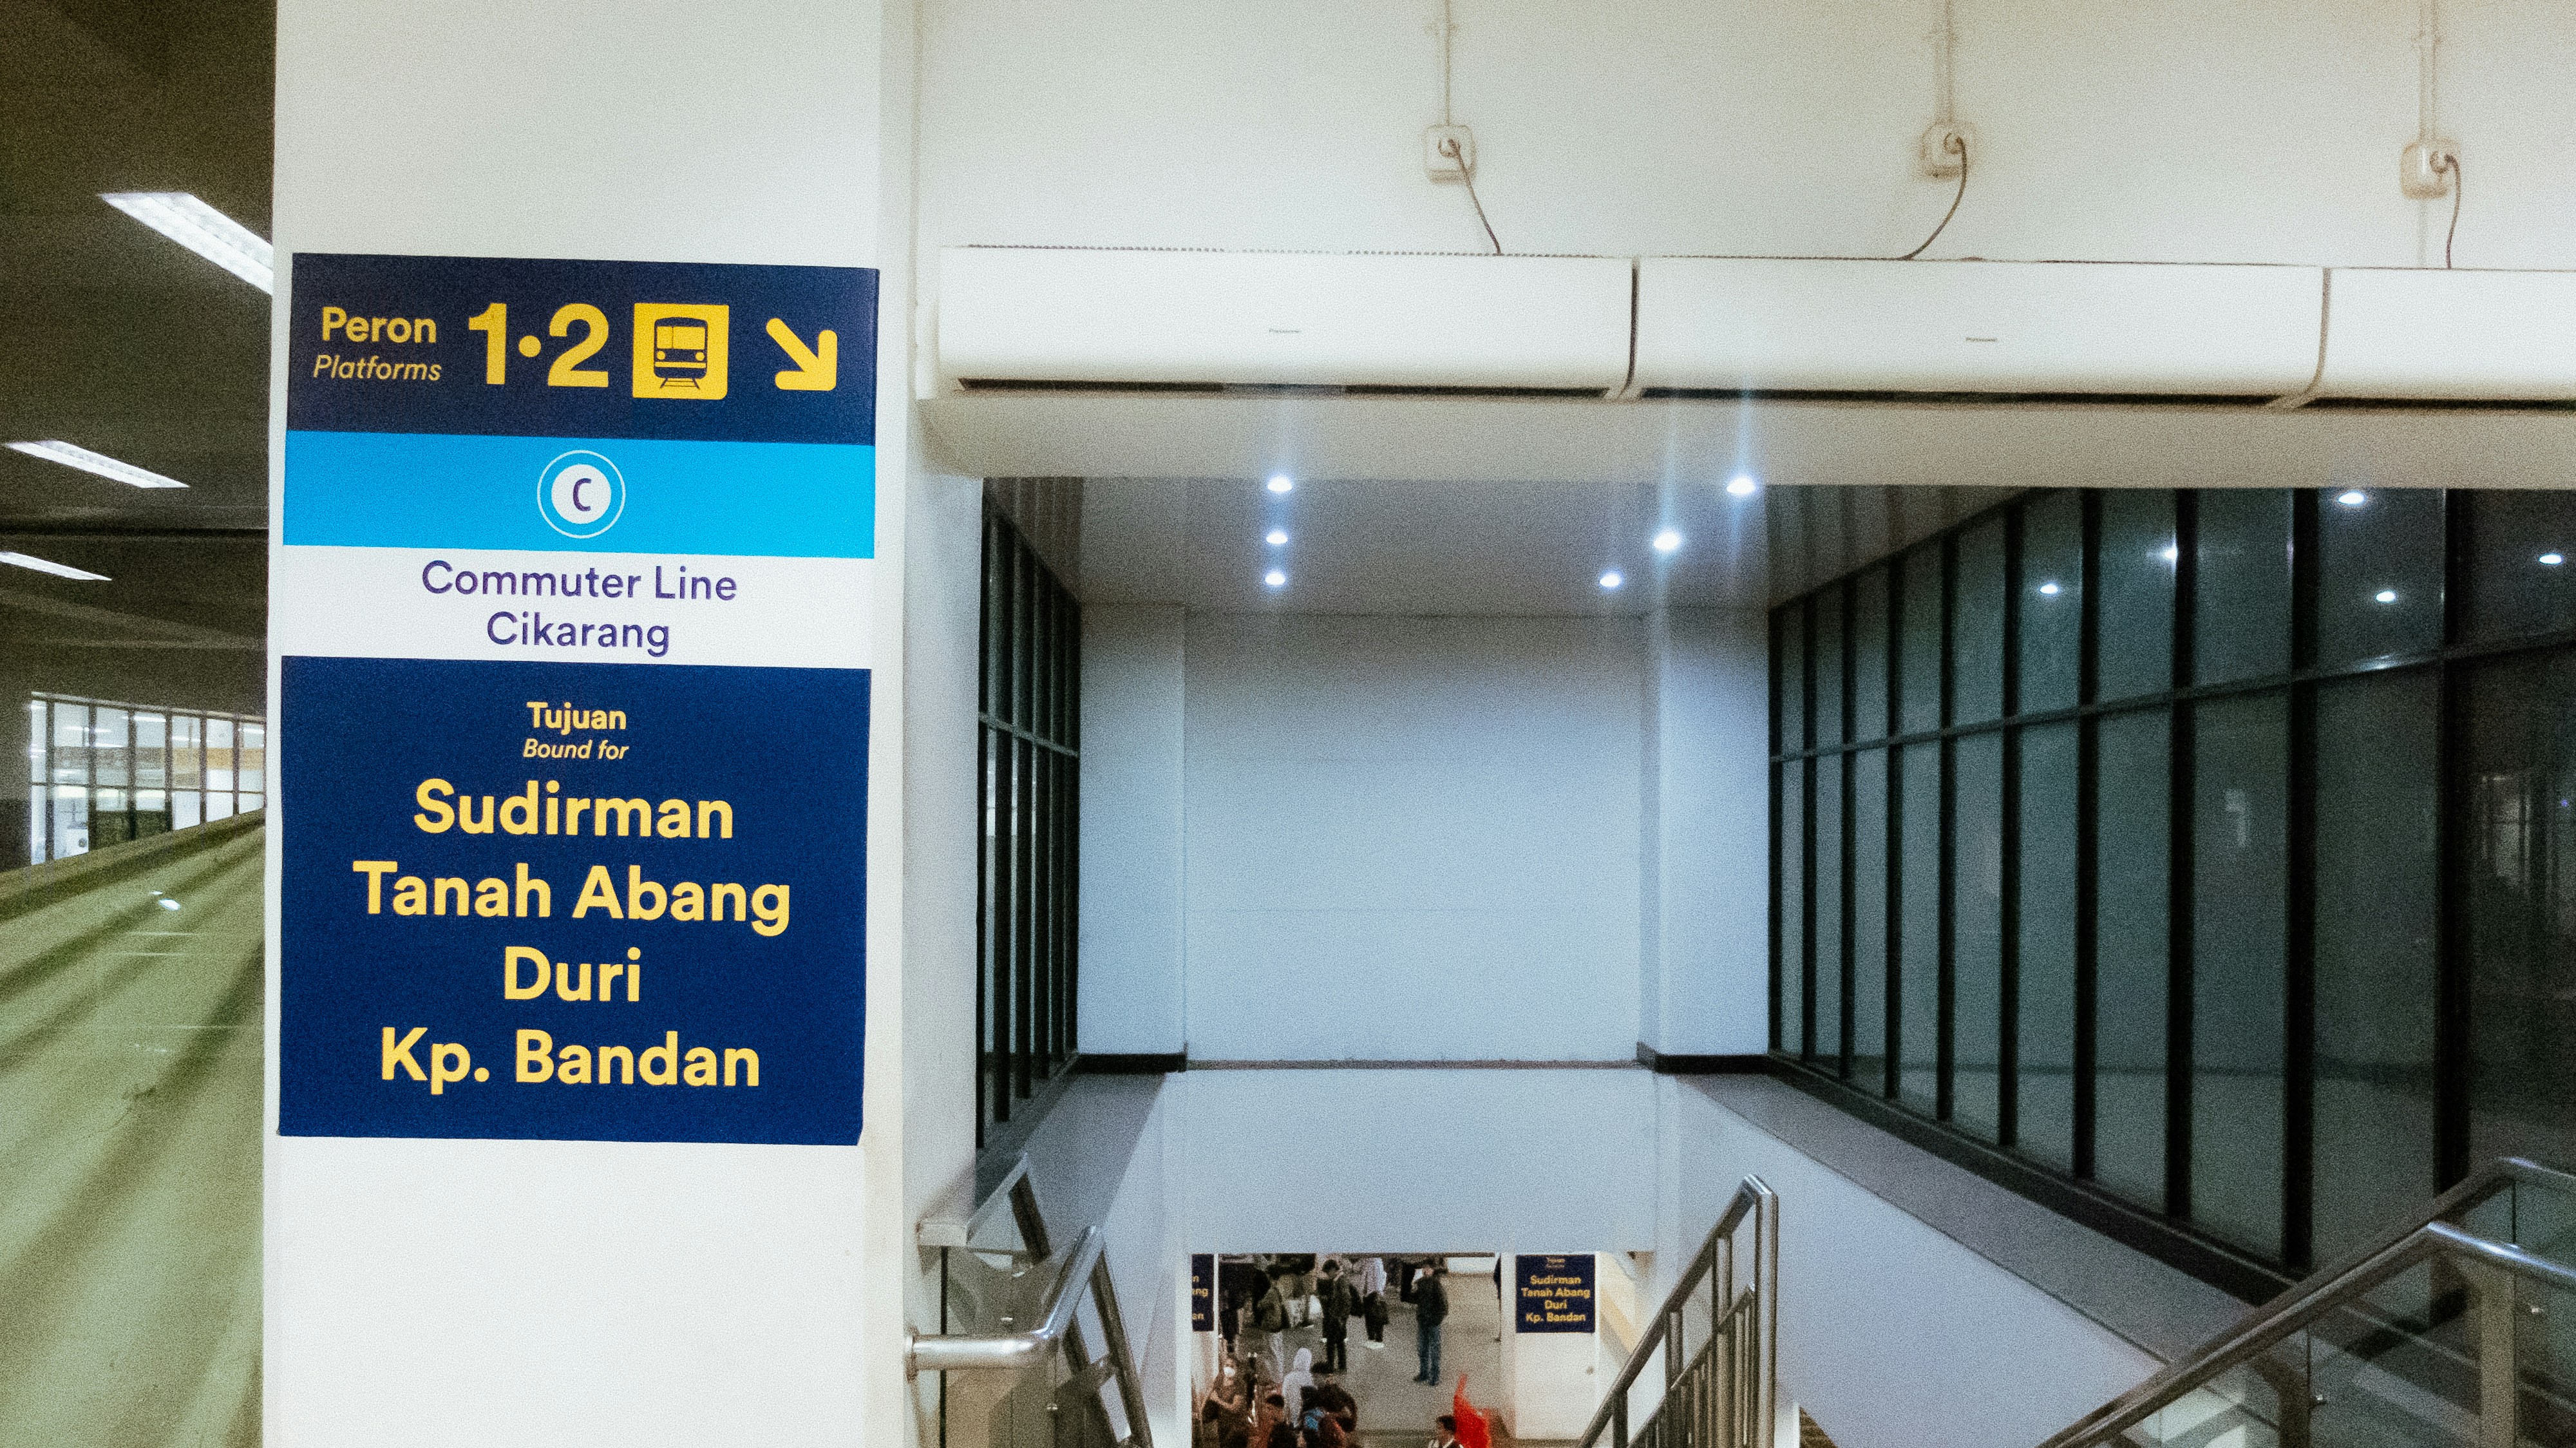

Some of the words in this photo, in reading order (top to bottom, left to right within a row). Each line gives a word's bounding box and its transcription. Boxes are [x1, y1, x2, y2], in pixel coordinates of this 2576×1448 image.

[322, 306, 437, 343] Peron
[312, 354, 442, 381] Platforms
[572, 478, 591, 511] C
[422, 560, 642, 598] Commuter
[654, 566, 737, 601] Line
[487, 611, 670, 658] Cikarang
[526, 701, 627, 736] Tujuan
[522, 738, 593, 759] Bound
[598, 739, 630, 761] for
[413, 778, 734, 839] Sudirman
[352, 860, 552, 917] Tanah
[572, 864, 791, 937] Abang
[504, 946, 642, 1002] Duri
[381, 1027, 490, 1095] Kp.
[515, 1029, 760, 1087] Bandan
[1520, 1287, 1553, 1297] Tanah
[1555, 1287, 1591, 1299] Abang
[1530, 1275, 1582, 1285] Sudirman
[1525, 1312, 1544, 1324] Kp.
[1546, 1311, 1586, 1322] Bandan
[1544, 1299, 1567, 1310] Duri
